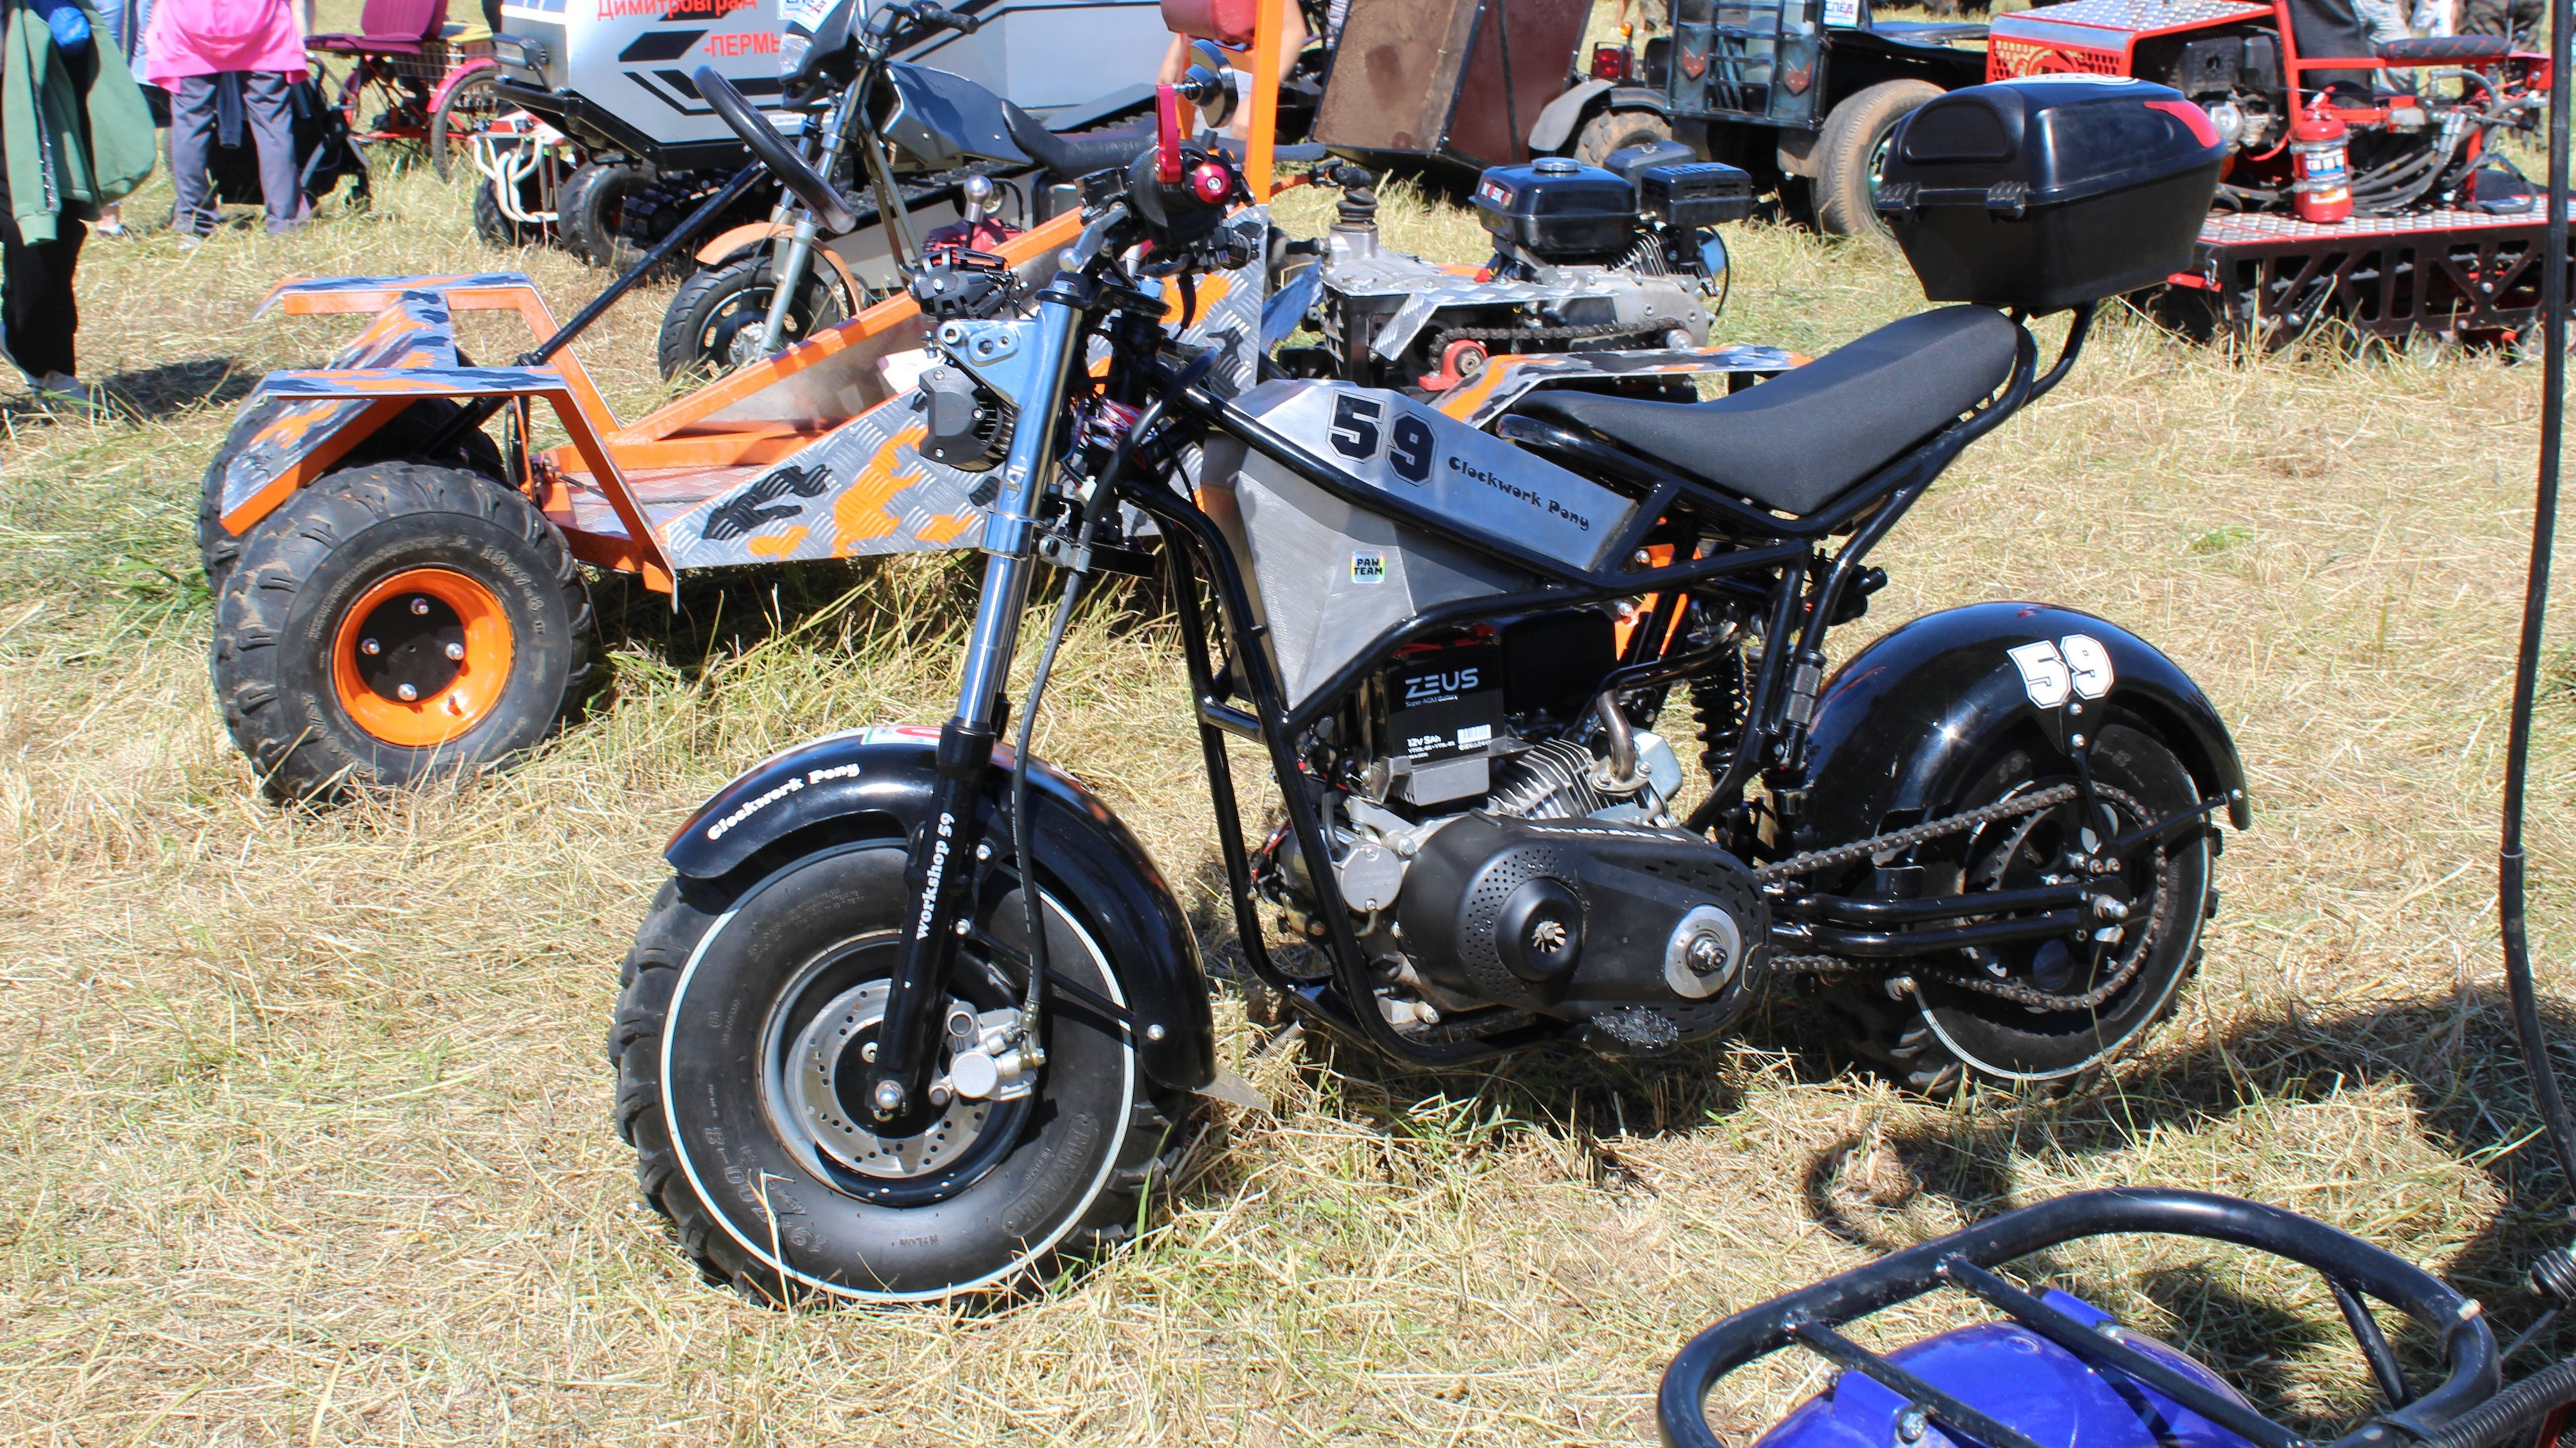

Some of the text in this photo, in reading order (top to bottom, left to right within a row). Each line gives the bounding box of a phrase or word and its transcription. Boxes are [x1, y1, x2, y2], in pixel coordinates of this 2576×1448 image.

[1325, 389, 1438, 487] 59
[1449, 456, 1590, 531] Clockwork Pony
[1357, 558, 1379, 567] PAW
[1405, 668, 1479, 699] ZEUS
[2006, 634, 2115, 709] 59
[706, 763, 860, 841] Clockwork Pony
[916, 812, 956, 940] workshop 59
